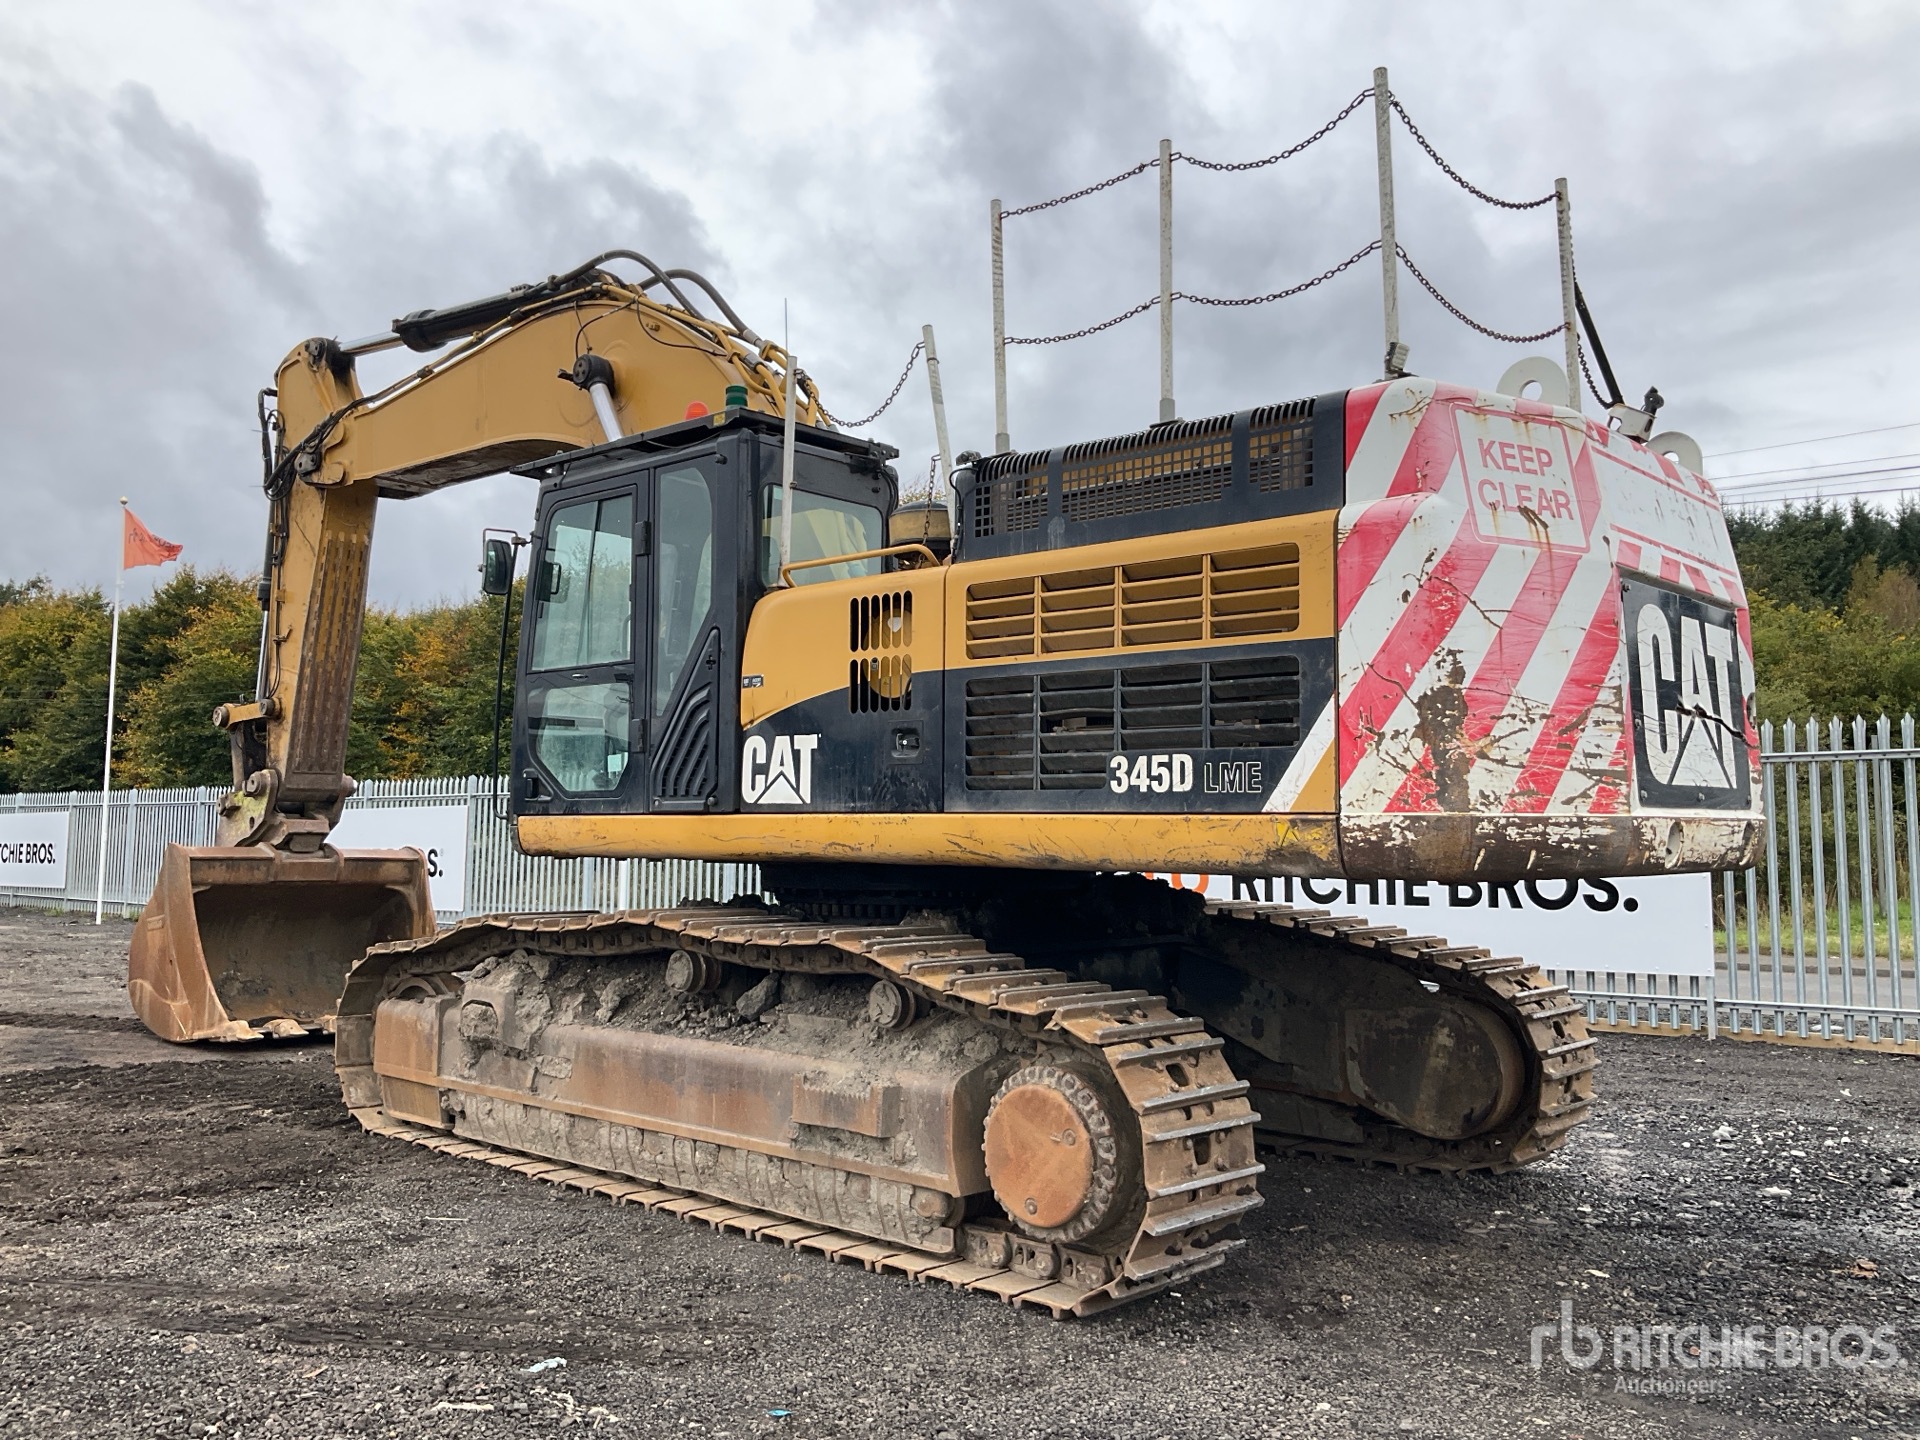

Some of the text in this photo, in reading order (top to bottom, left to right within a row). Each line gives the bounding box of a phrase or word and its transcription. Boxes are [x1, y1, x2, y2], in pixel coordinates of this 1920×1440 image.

[1477, 438, 1553, 476] KEEP
[1477, 478, 1574, 521] CLEAR
[1637, 603, 1738, 789] CAT
[741, 734, 818, 804] CAT
[1109, 753, 1262, 794] 345D LME
[25, 842, 56, 865] BROS.
